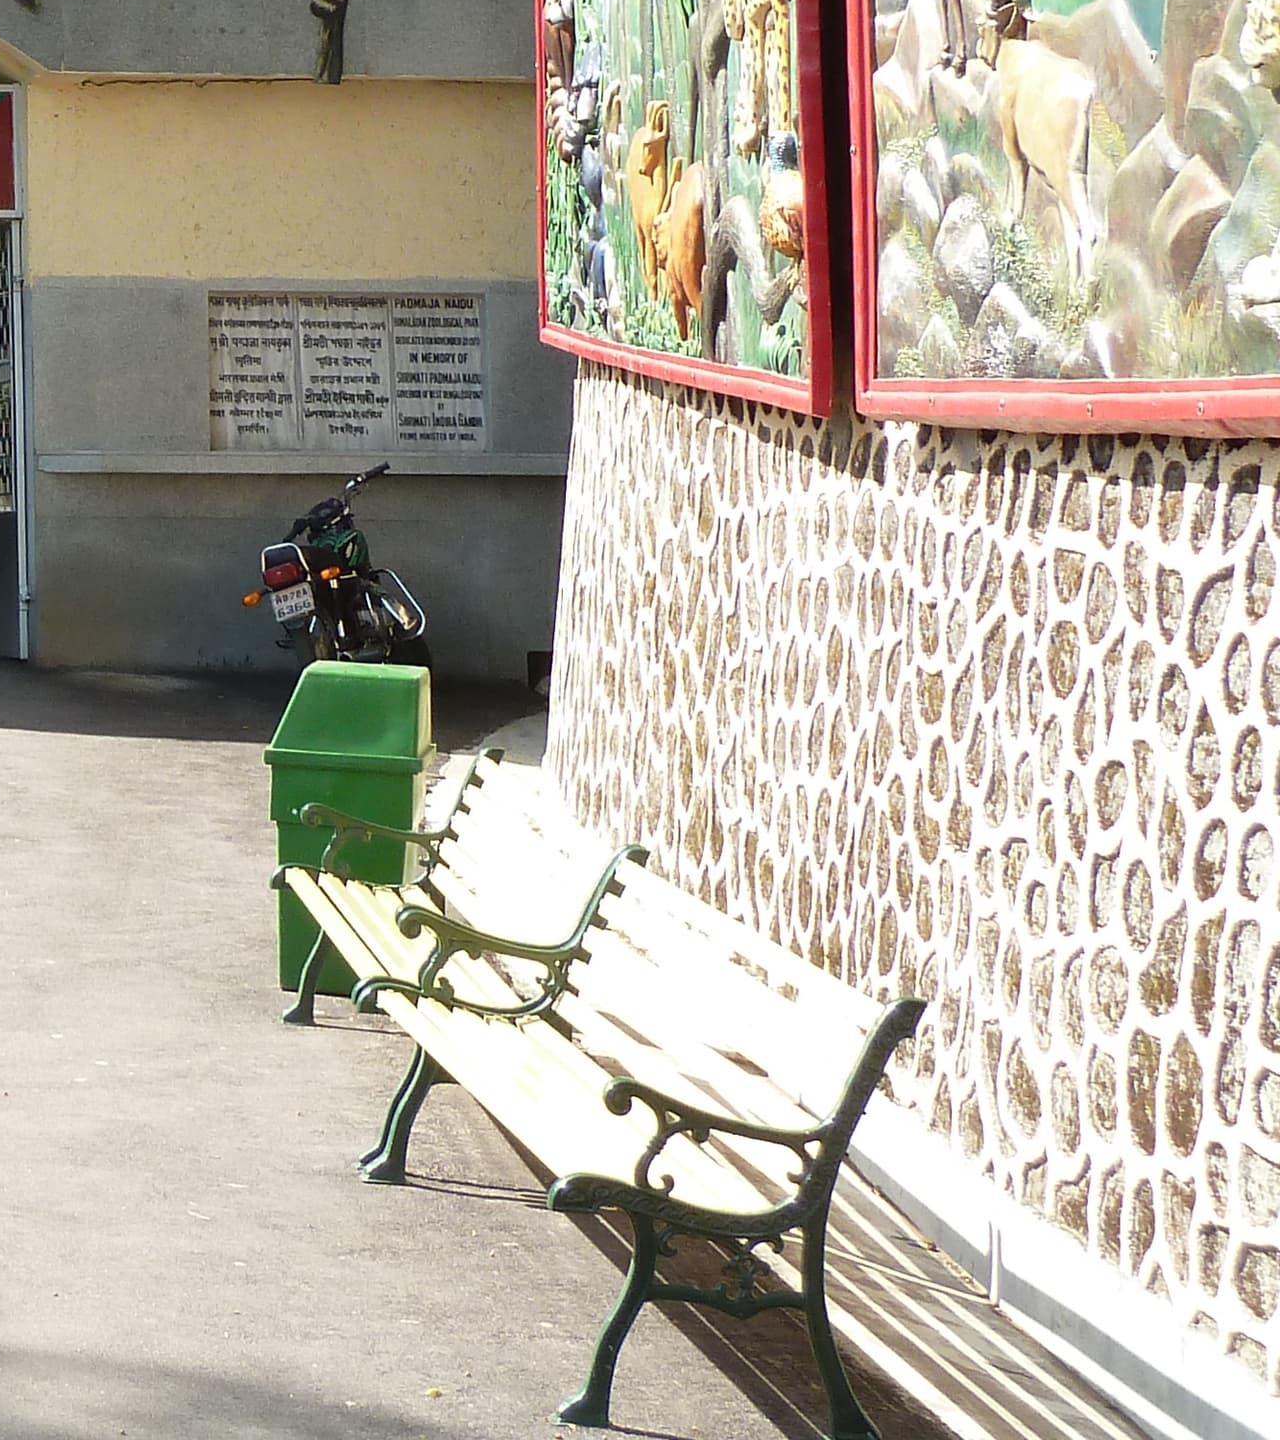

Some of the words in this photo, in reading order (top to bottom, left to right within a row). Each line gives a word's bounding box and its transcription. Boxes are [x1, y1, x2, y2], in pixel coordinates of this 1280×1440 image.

[394, 298, 440, 309] PADMAJA
[445, 298, 474, 309] NAIDU
[409, 352, 418, 363] IN
[421, 352, 455, 363] MEMORY
[457, 352, 468, 363] OF
